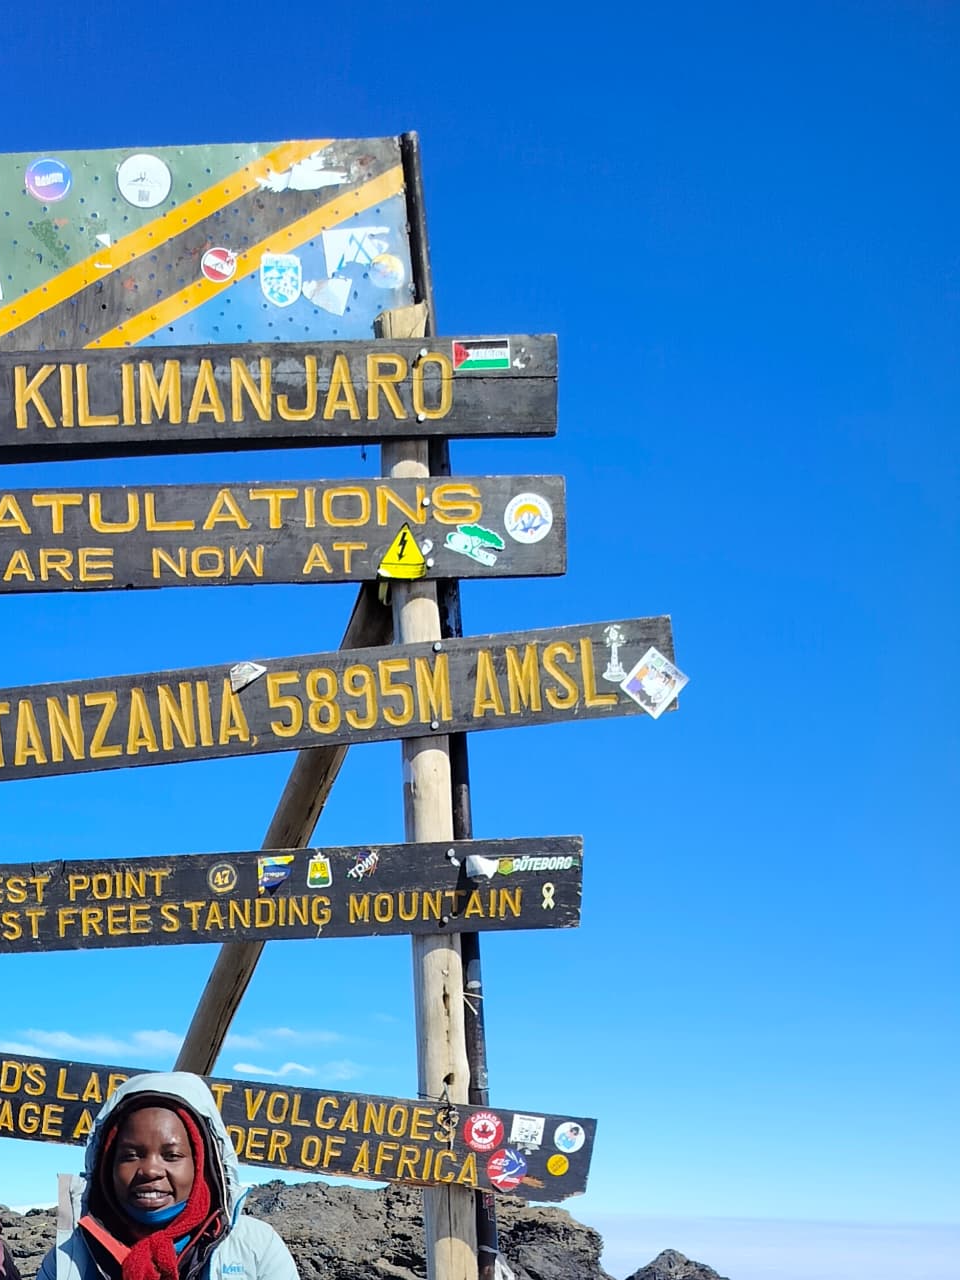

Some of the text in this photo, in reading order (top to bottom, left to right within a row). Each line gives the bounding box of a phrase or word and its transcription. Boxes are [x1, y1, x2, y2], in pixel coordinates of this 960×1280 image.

[14, 351, 454, 430] KILIMANJARO
[2, 547, 114, 583] ARE
[151, 544, 265, 579] NOW
[302, 541, 368, 575] AT
[265, 653, 453, 738] 5895M
[472, 636, 619, 718] AMSL
[68, 869, 170, 902] POINT
[213, 869, 231, 886] 47
[347, 887, 523, 924] MOUNTAIN
[243, 1088, 457, 1143] VOLCANOES
[471, 1112, 501, 1127] CANADA
[300, 1134, 346, 1168] OF
[351, 1140, 479, 1188] AFRICA
